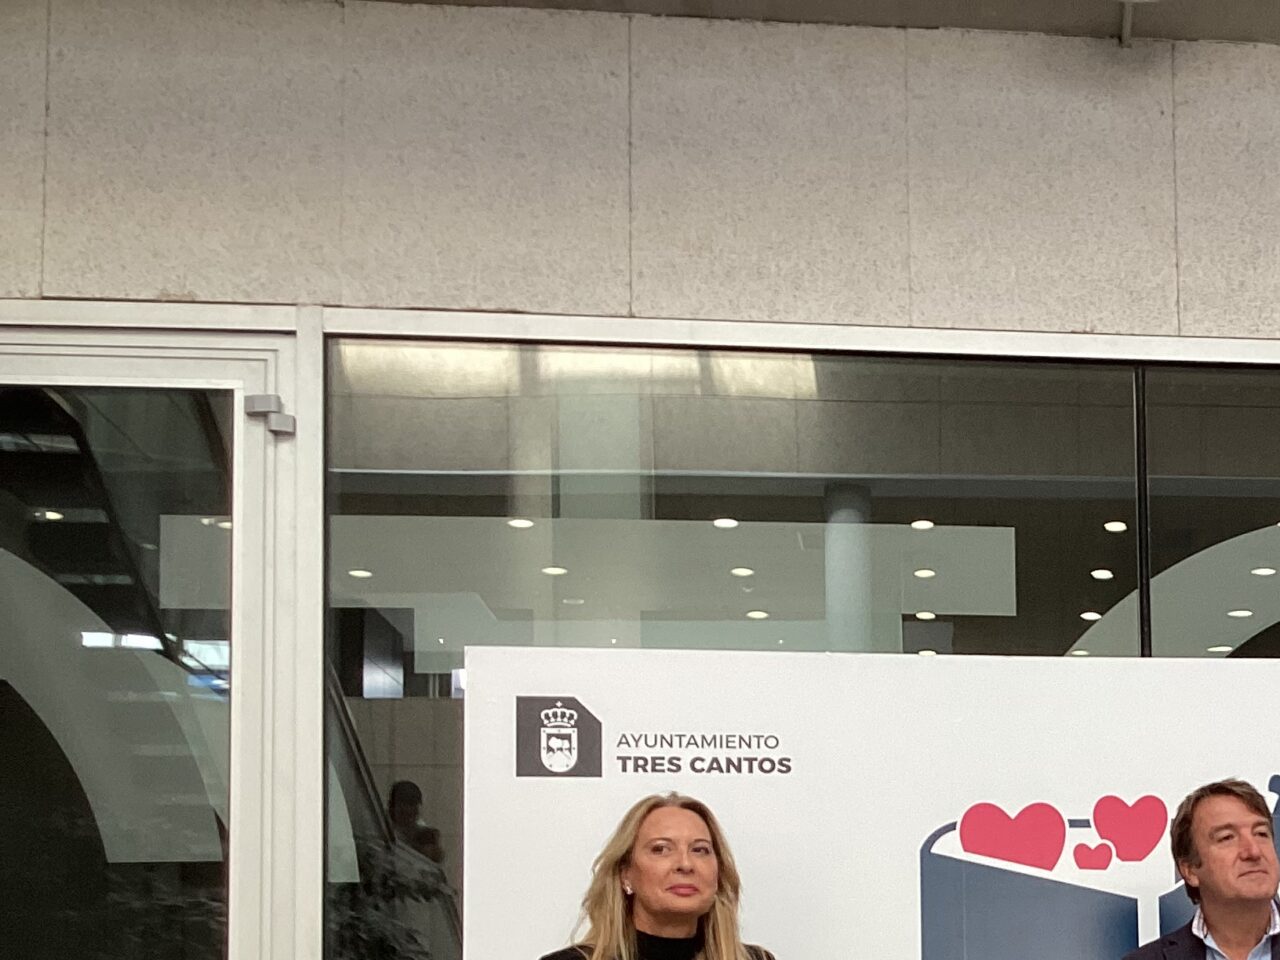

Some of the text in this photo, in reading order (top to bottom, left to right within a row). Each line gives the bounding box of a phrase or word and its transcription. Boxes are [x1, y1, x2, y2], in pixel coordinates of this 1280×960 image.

[616, 733, 780, 750] AYUNTAMIENTO
[616, 755, 792, 774] TRES CANTOS
